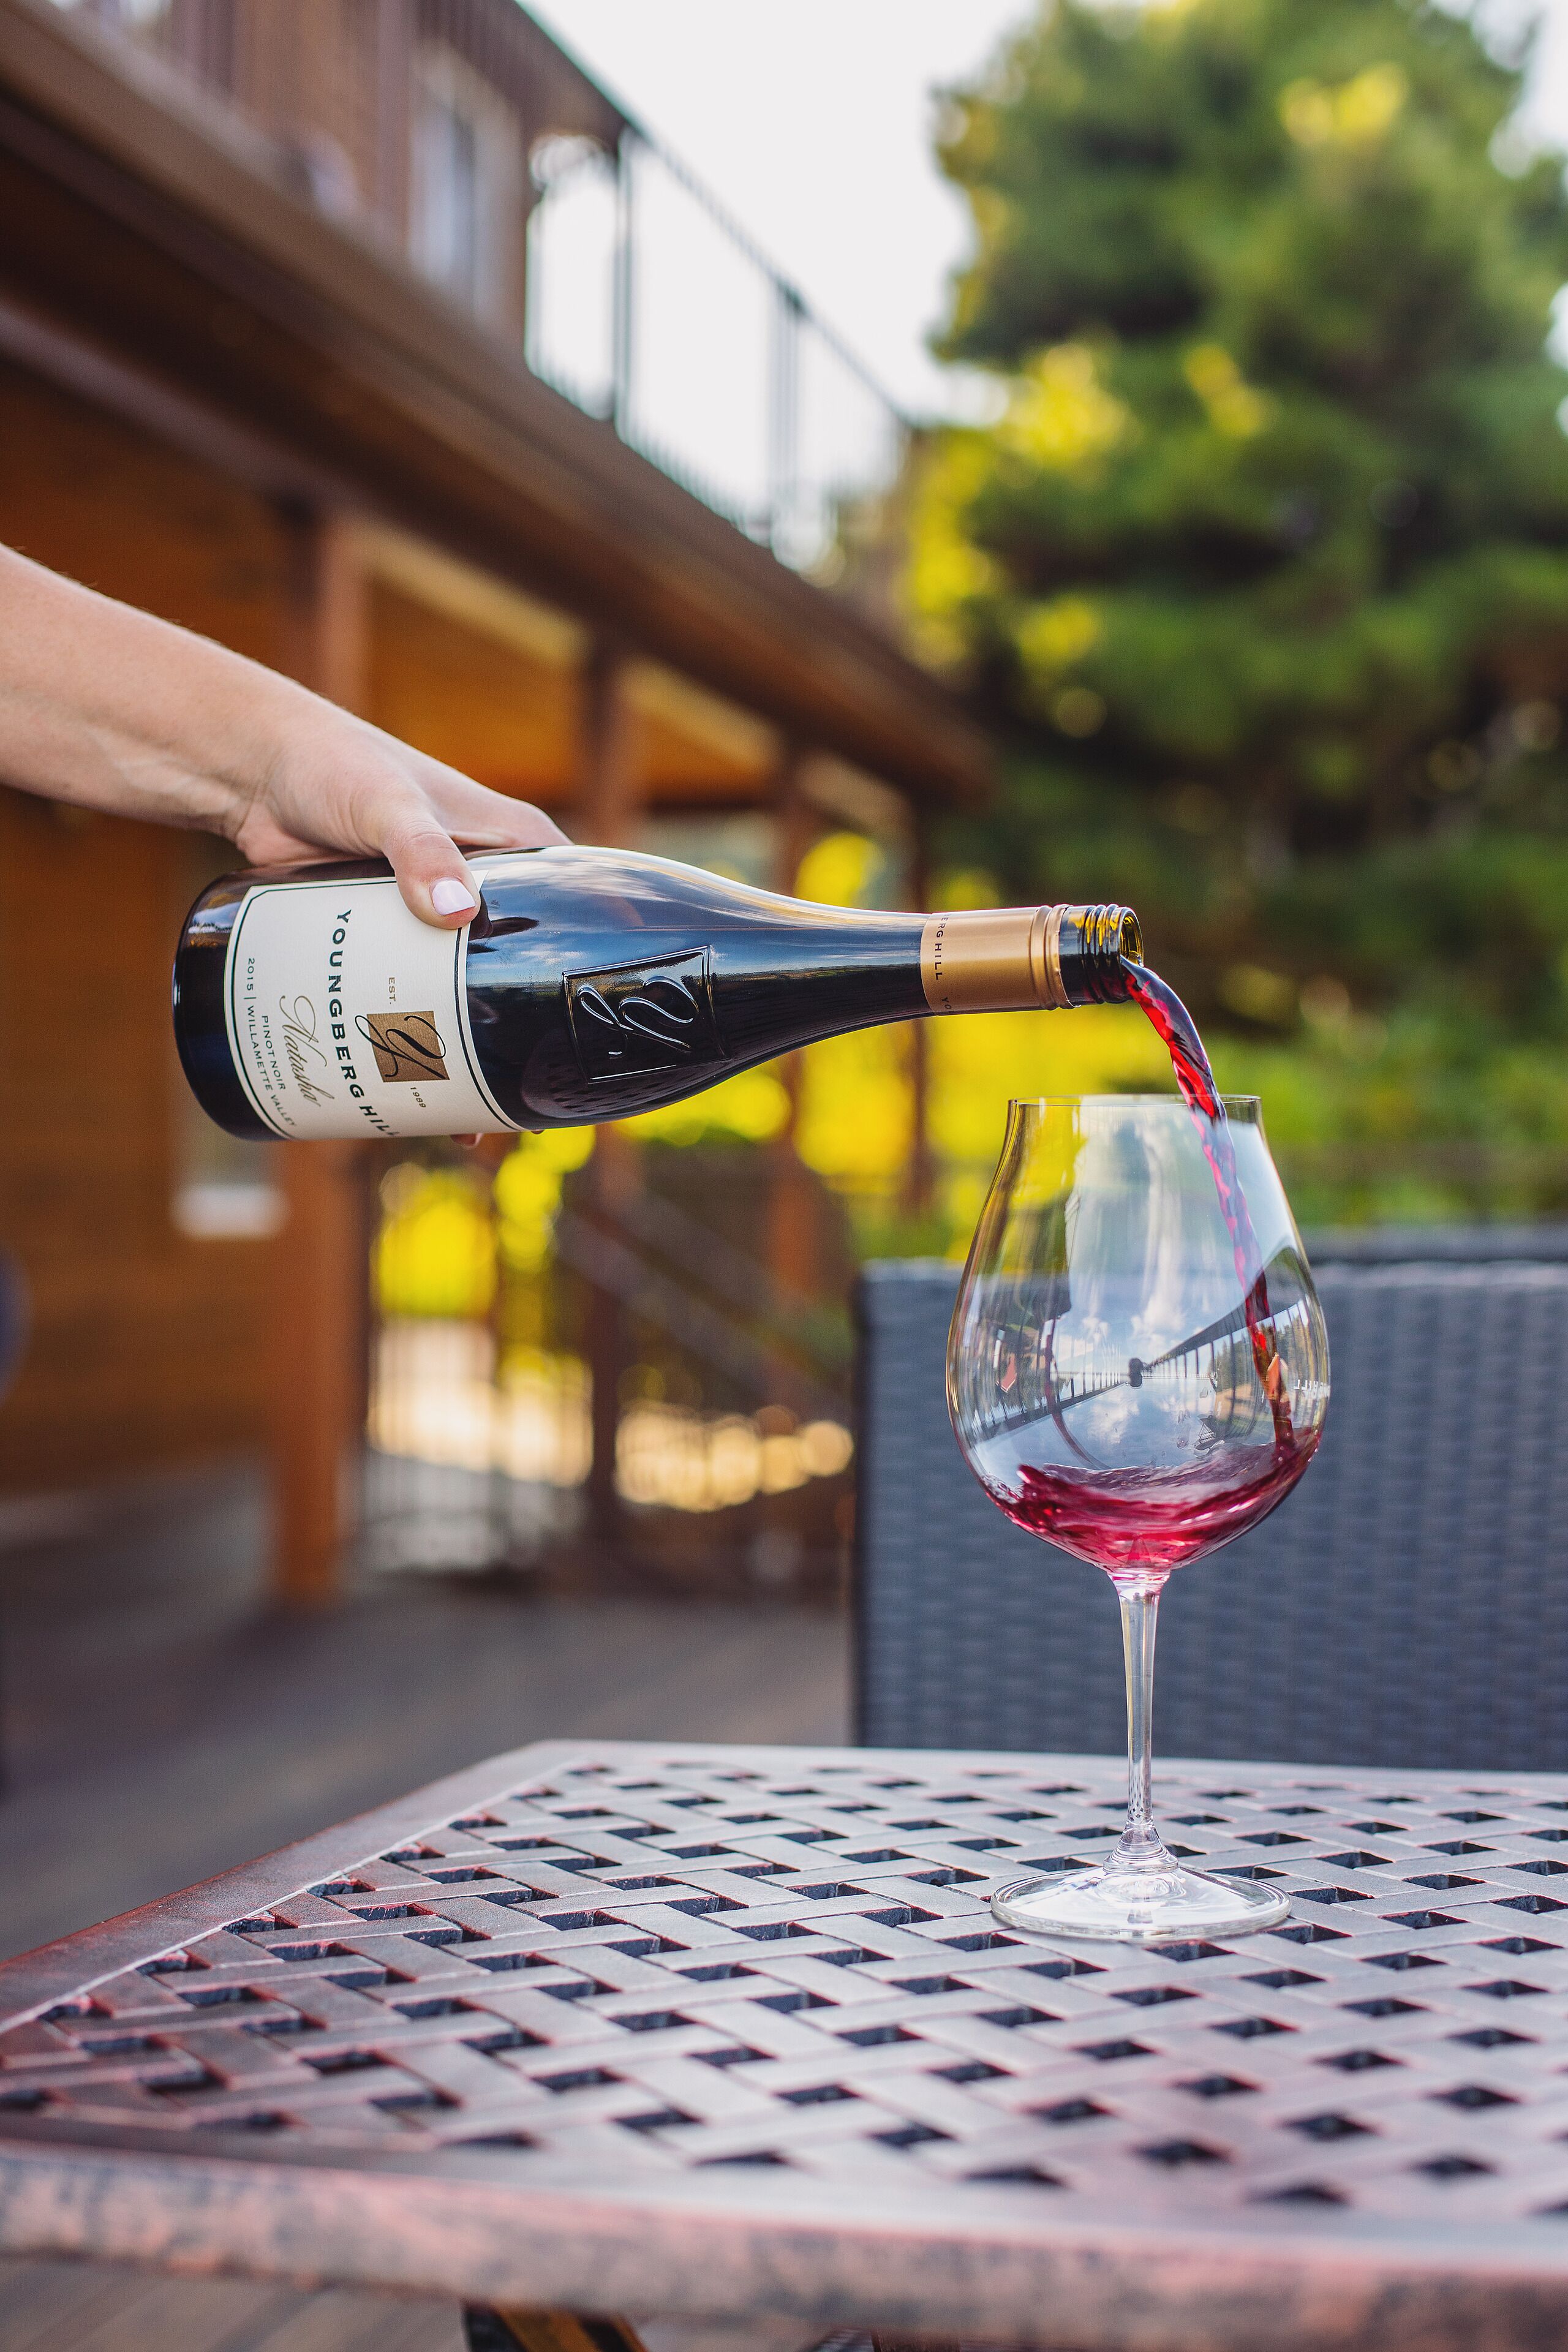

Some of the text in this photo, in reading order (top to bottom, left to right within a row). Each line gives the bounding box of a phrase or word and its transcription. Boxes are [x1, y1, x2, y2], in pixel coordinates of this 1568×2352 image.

[247, 958, 255, 991] 2015
[328, 910, 364, 1098] YOUNGBERG
[247, 1005, 273, 1091] WILLAMETTE
[262, 1016, 285, 1090] PINOT NOIR
[279, 995, 335, 1107] Natasha
[271, 1095, 296, 1126] VALLEY
[410, 1087, 426, 1108] 1989
